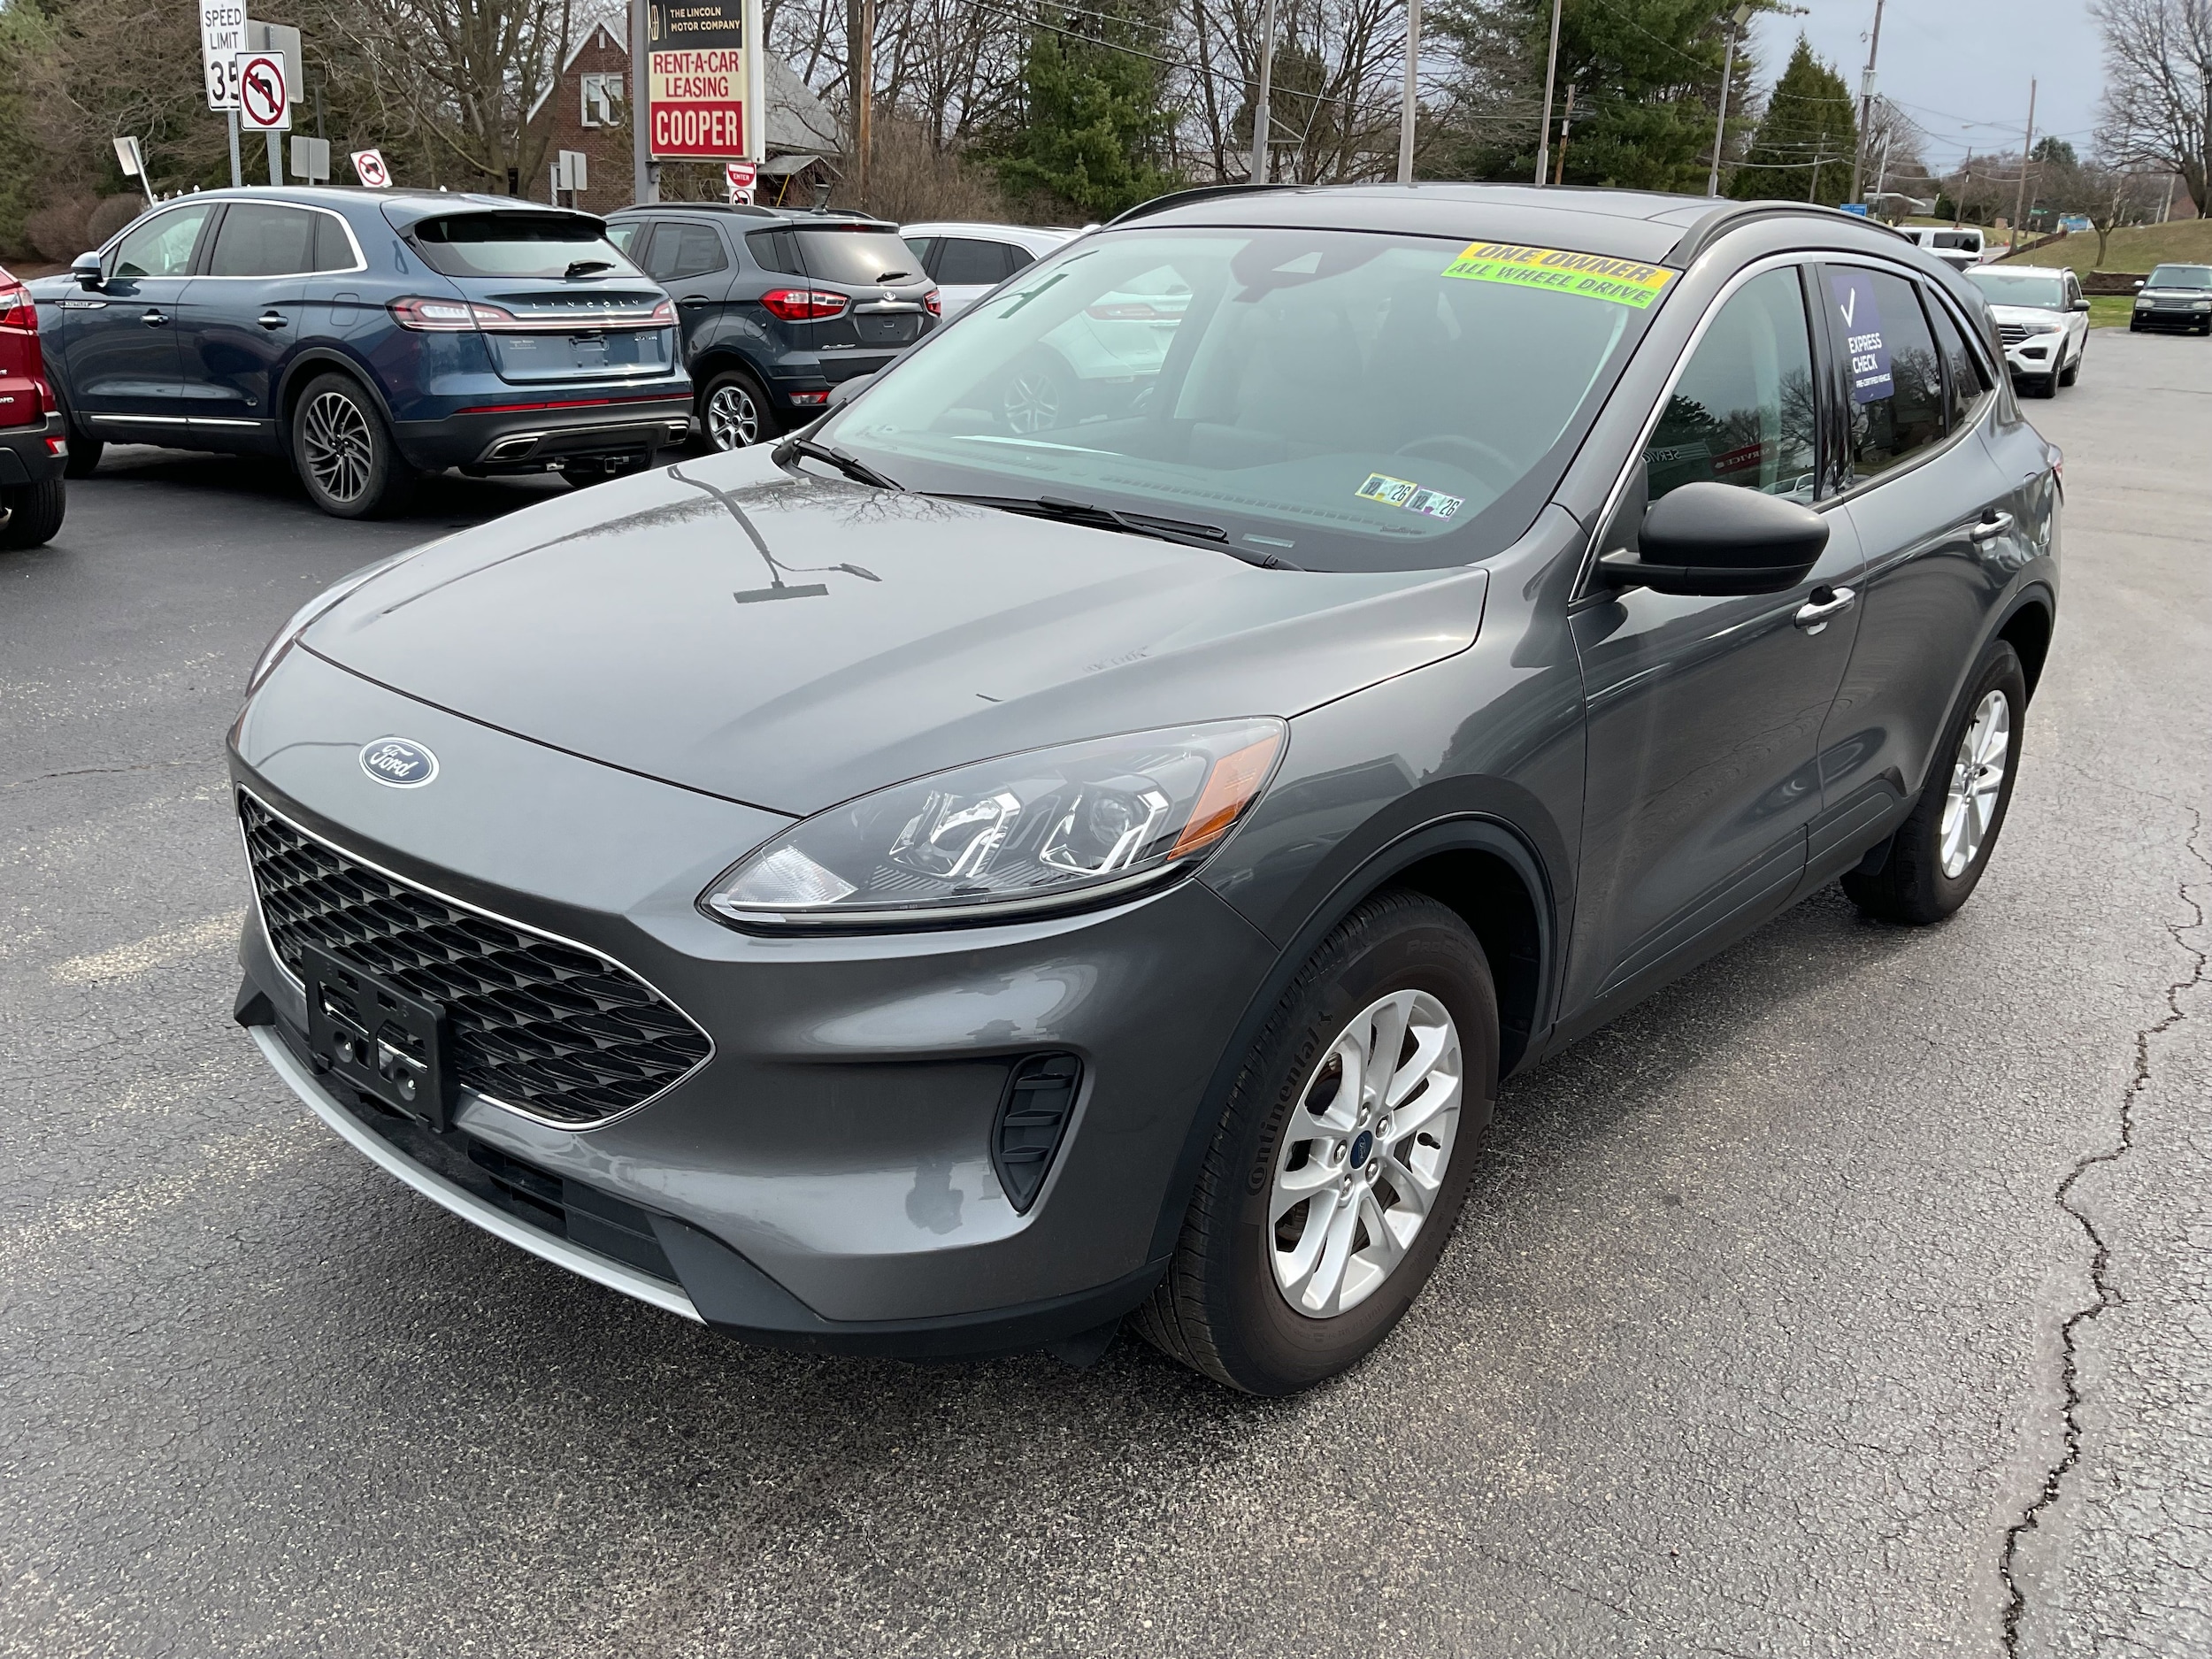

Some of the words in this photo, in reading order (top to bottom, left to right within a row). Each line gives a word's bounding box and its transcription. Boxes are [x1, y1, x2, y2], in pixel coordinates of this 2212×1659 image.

[205, 8, 242, 27] SPEED
[670, 8, 686, 18] THE
[687, 6, 721, 18] LINCOLN
[671, 22, 699, 32] MOTOR
[700, 19, 741, 31] COMPANY
[210, 32, 238, 50] LIMIT
[653, 51, 739, 74] RENT-A-CAR
[665, 76, 728, 97] LEASING
[657, 110, 738, 146] COOPER
[733, 173, 750, 181] ENTER
[1472, 245, 1543, 264] ONE
[1540, 250, 1658, 283] OWNER
[1448, 262, 1488, 277] ALL
[1496, 266, 1572, 288] WHEEL
[1576, 281, 1655, 304] DRIVE
[533, 299, 639, 310] LINCOLN
[1847, 332, 1882, 354] EXPRESS
[1852, 353, 1878, 373] CHECK
[1364, 481, 1381, 495] 12
[1391, 484, 1411, 503] 26
[1413, 495, 1430, 511] 12
[1439, 498, 1460, 517] 26
[370, 744, 419, 777] Ford
